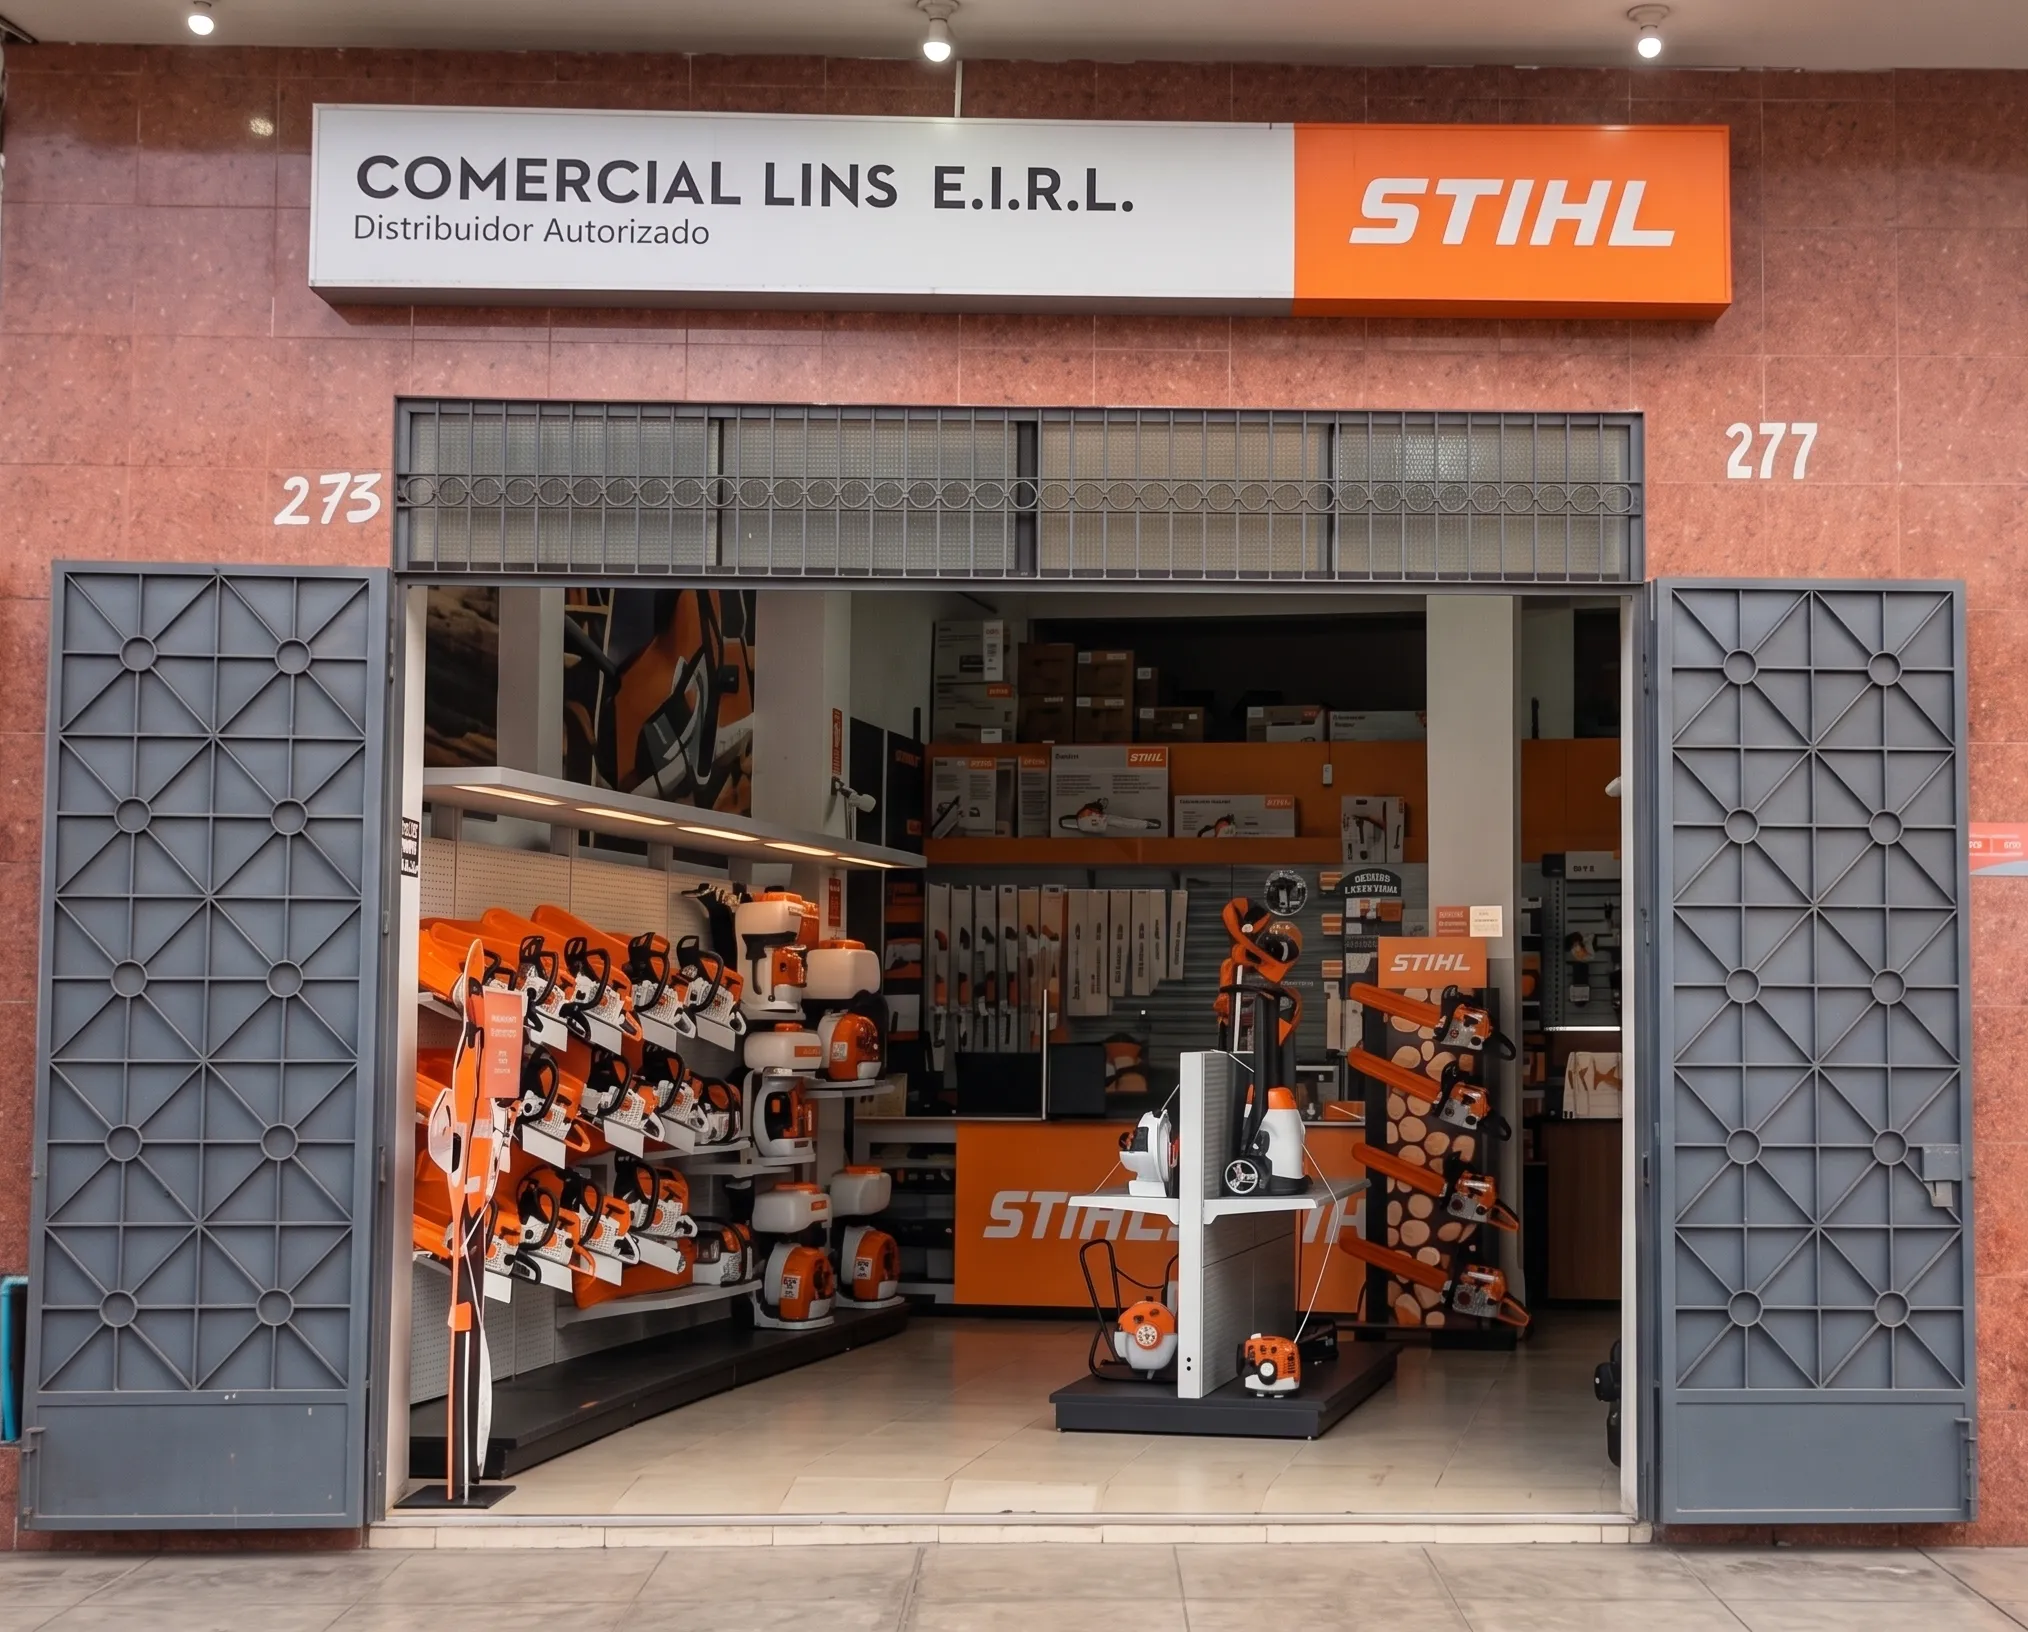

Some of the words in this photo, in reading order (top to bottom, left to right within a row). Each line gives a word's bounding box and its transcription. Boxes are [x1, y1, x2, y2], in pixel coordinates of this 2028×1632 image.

[356, 154, 742, 206] COMERCIAL
[764, 162, 898, 209] LINS
[934, 165, 1134, 213] E.I.R.L.
[354, 214, 534, 242] Distribuidor
[543, 218, 709, 245] Autorizado
[1348, 177, 1676, 247] STIHL
[1725, 422, 1818, 480] 277
[273, 471, 382, 526] 273
[1390, 953, 1471, 972] STIHL
[983, 1190, 1164, 1241] STIHL
